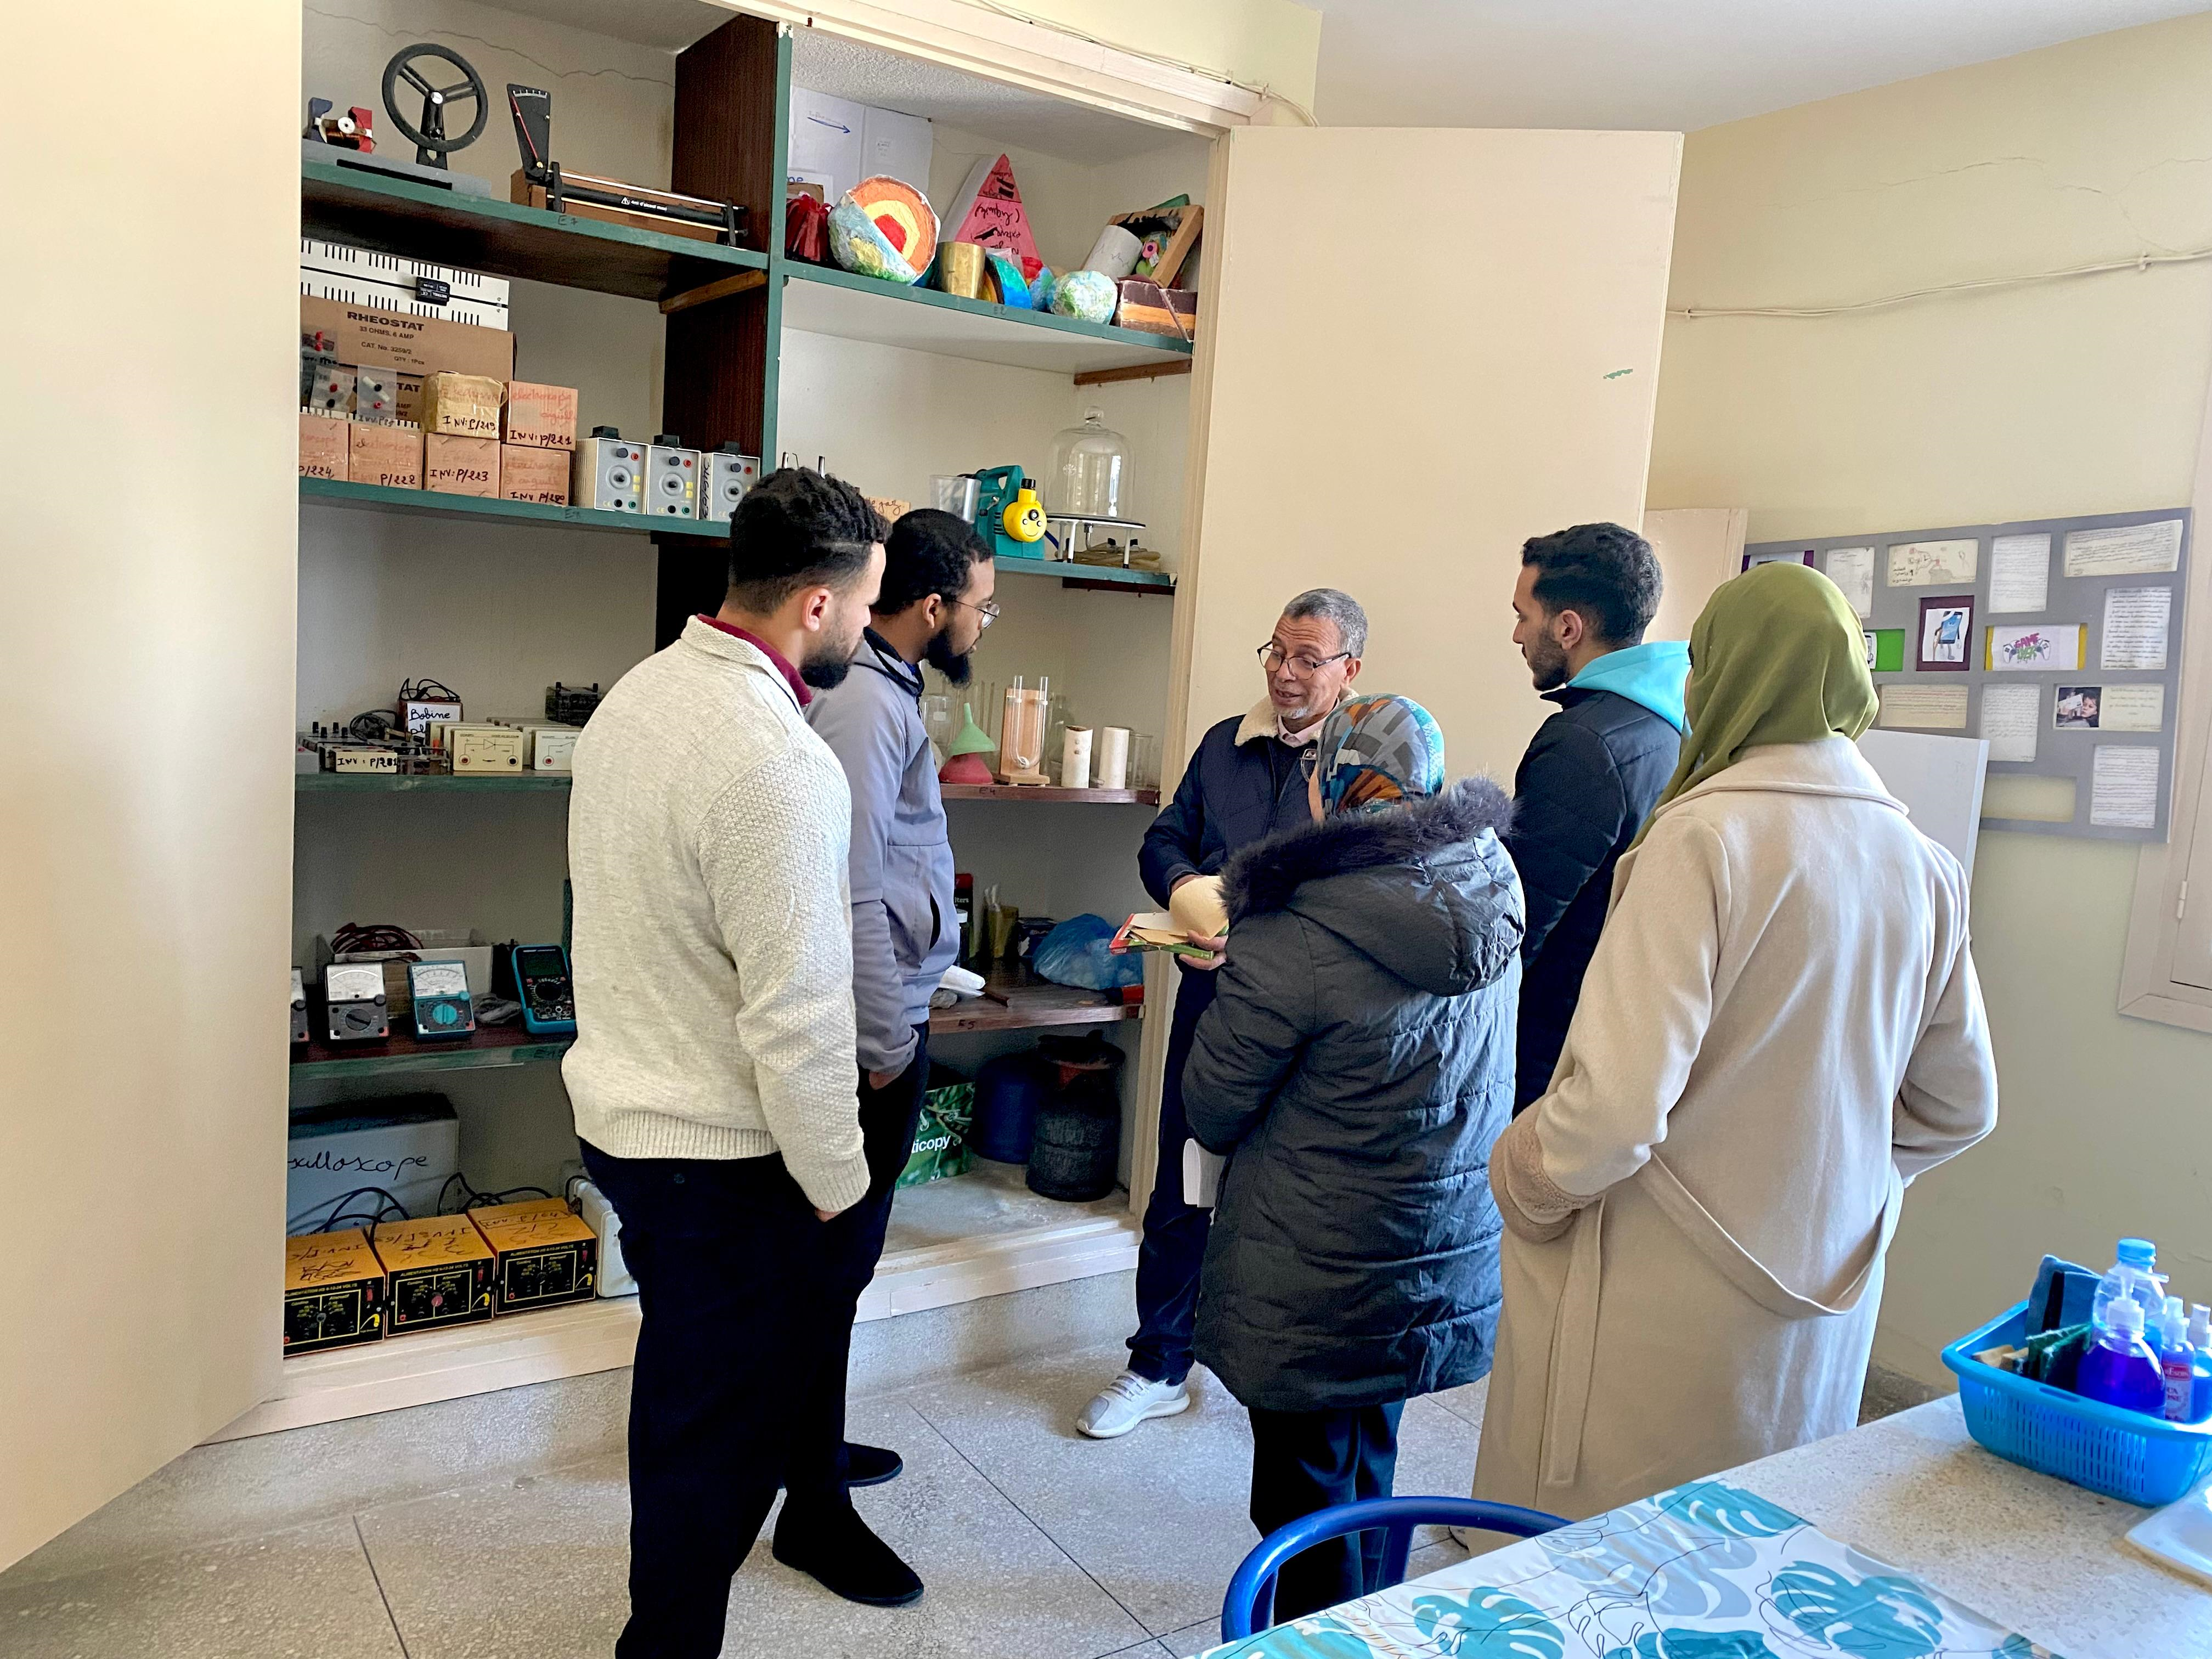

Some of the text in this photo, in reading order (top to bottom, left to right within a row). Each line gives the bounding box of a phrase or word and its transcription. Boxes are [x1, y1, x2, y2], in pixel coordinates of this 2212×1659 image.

[347, 311, 424, 331] RHEOSTAT
[380, 473, 416, 486] P/222
[456, 469, 488, 483] P/223
[2015, 633, 2040, 648] GAME
[409, 707, 451, 721] Bobine
